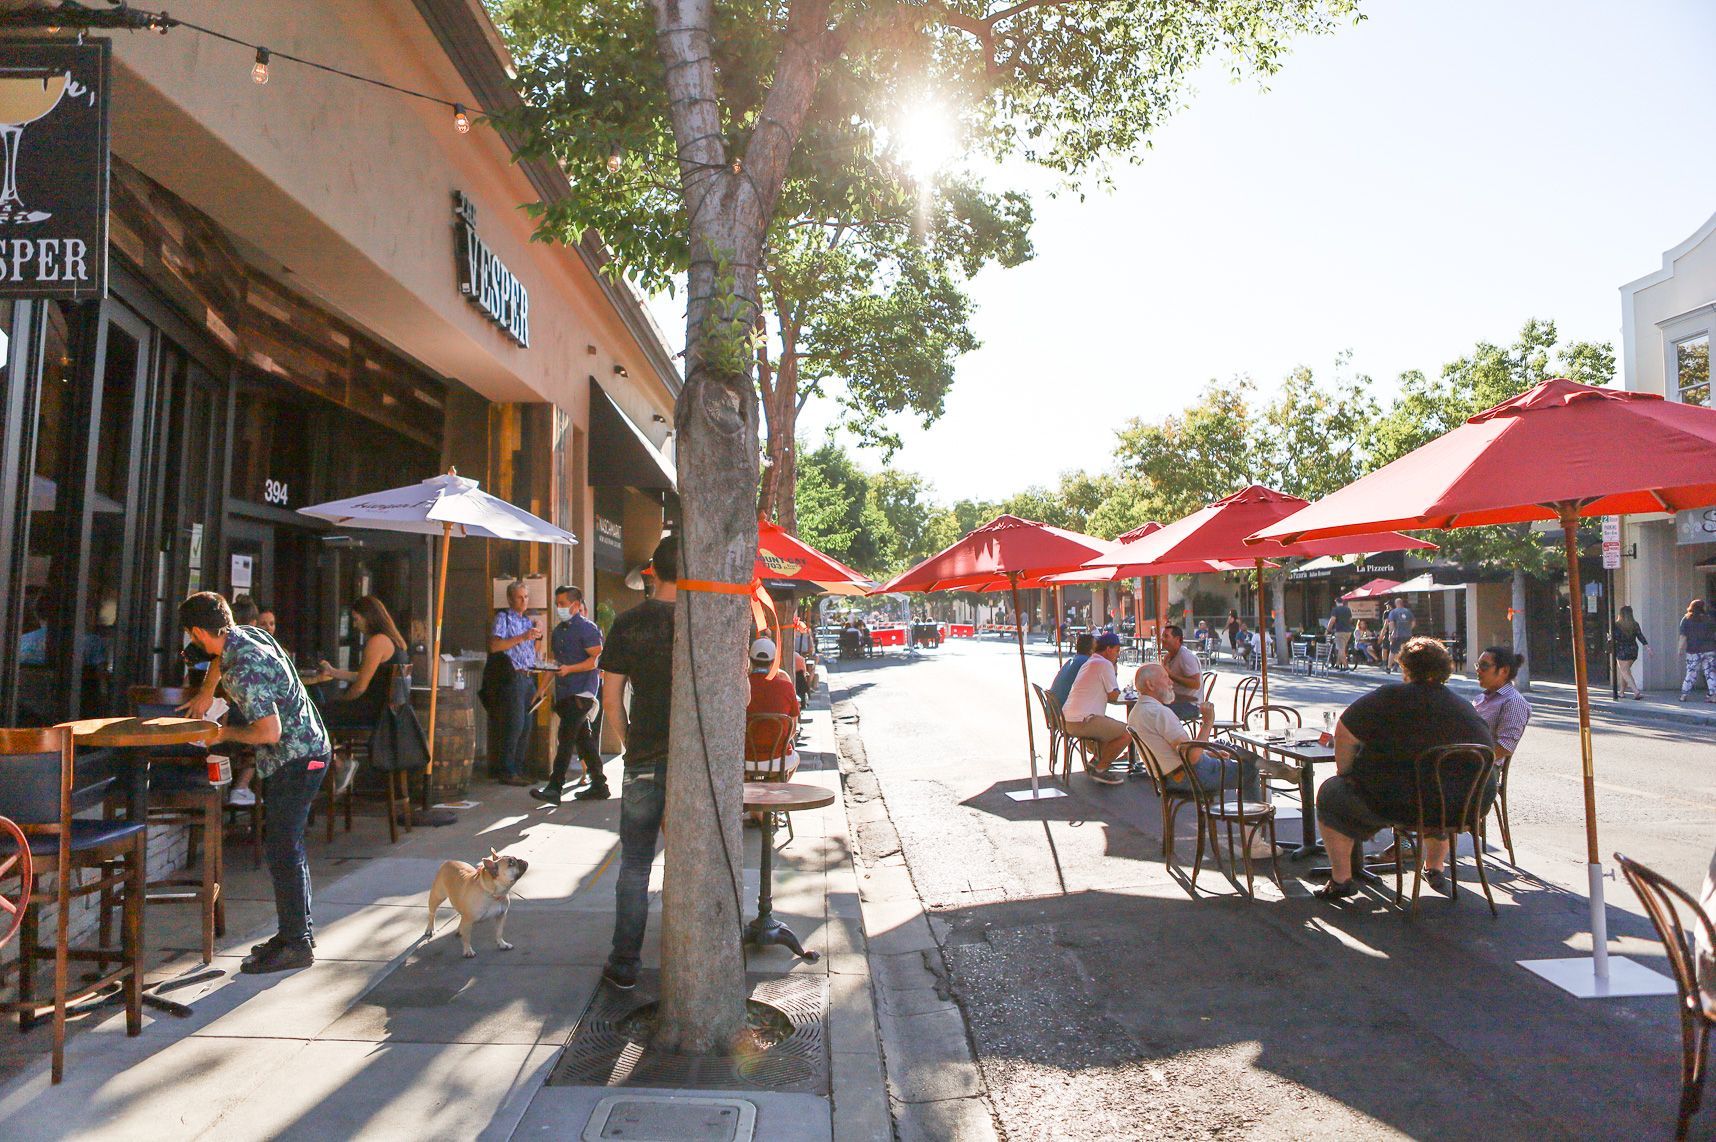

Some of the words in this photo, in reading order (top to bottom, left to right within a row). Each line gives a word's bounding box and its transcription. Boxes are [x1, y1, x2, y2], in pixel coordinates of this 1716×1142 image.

[0, 238, 88, 281] PER
[466, 224, 529, 348] VESPER
[264, 479, 288, 505] 394
[1356, 565, 1366, 573] La
